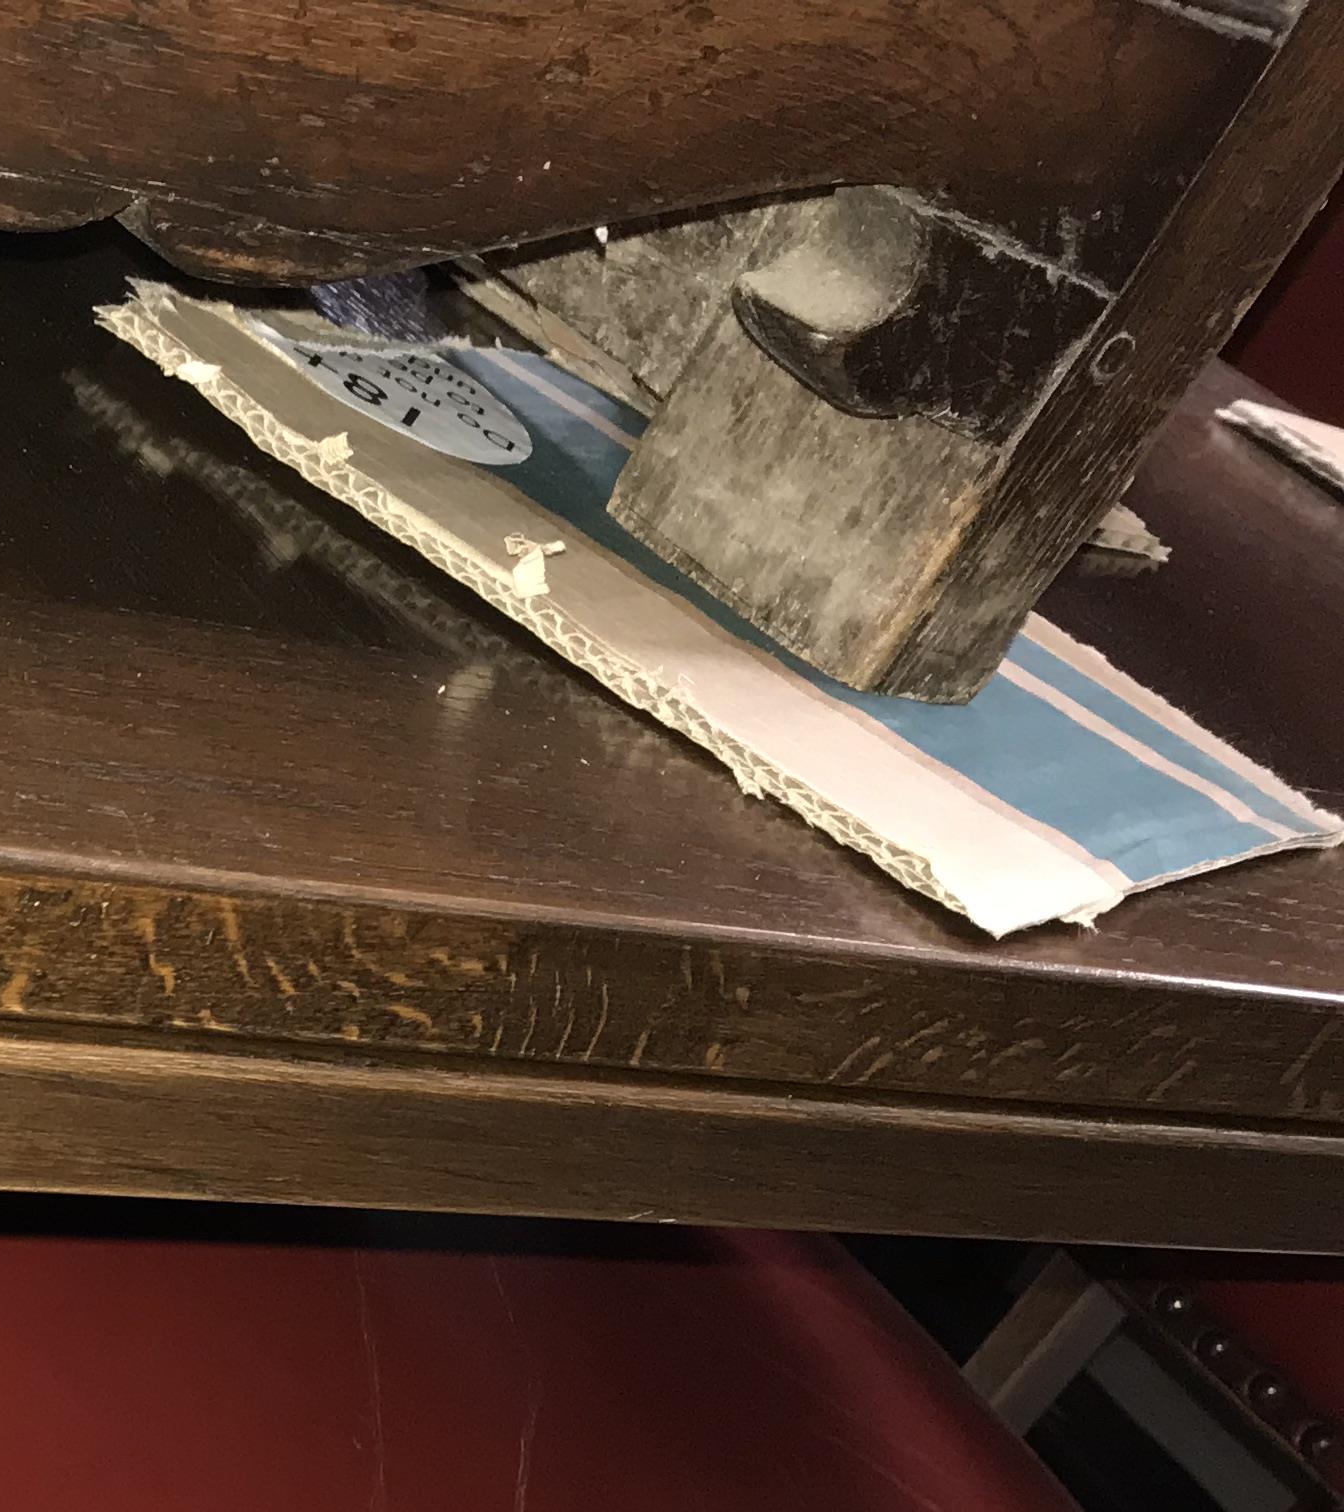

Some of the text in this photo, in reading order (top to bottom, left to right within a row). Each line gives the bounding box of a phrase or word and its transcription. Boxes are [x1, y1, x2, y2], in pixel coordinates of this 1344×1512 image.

[294, 347, 421, 427] 18+
[378, 367, 441, 407] not
[446, 391, 485, 416] to
[457, 412, 516, 452] Do
